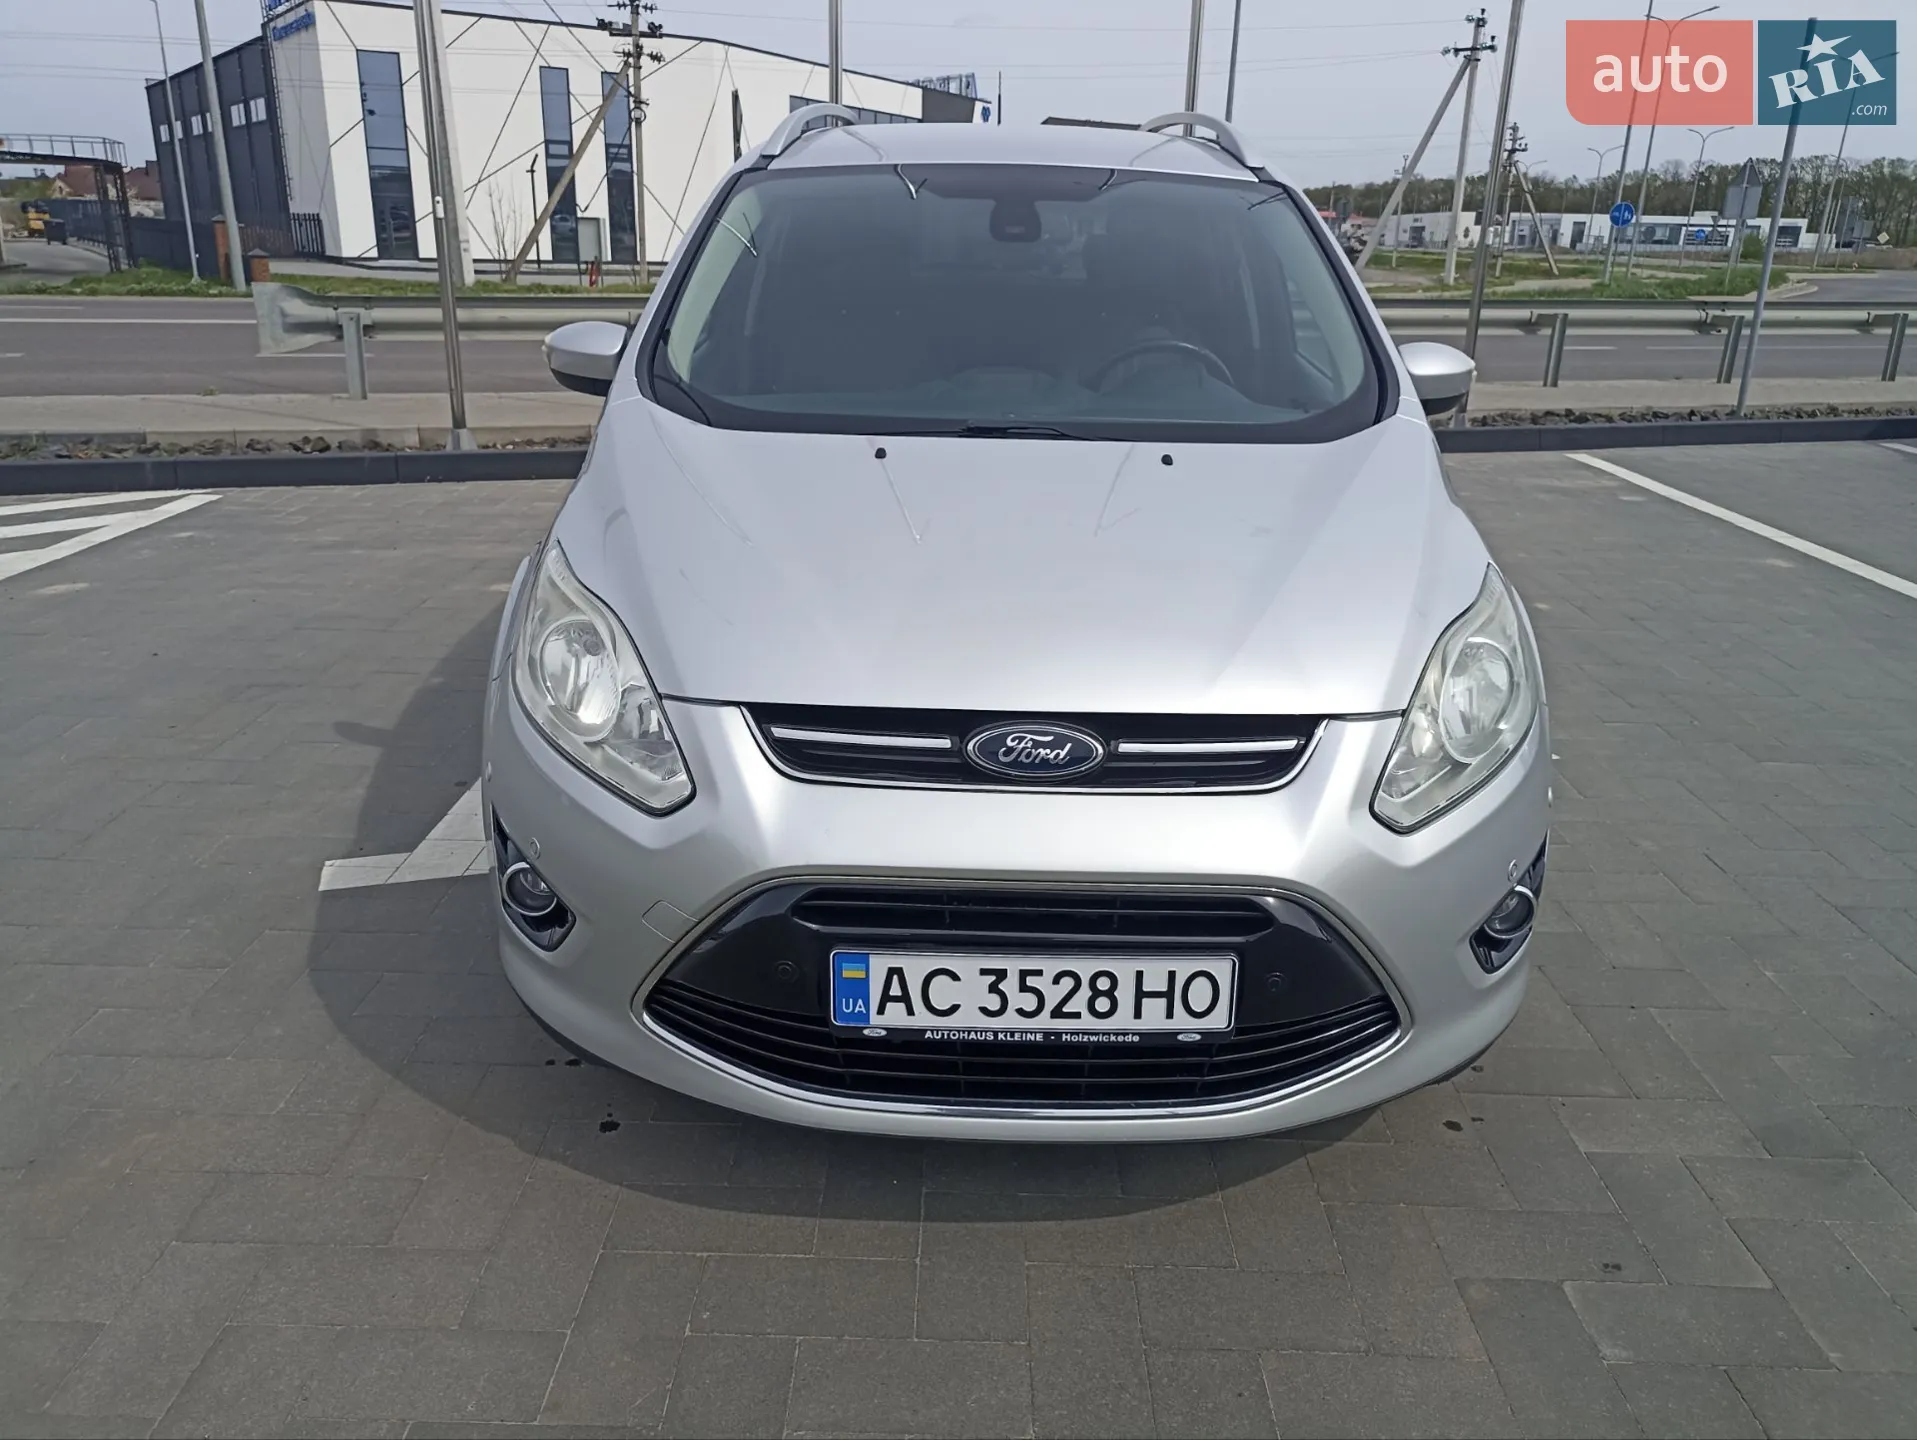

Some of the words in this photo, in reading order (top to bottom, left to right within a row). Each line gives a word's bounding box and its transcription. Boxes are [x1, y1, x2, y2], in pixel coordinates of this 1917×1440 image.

[998, 733, 1072, 765] Ford
[876, 966, 961, 1018] AC
[978, 968, 1119, 1020] 3528
[1133, 969, 1220, 1020] HO
[842, 998, 866, 1014] UA
[924, 1030, 994, 1040] AUTOHAUS
[998, 1032, 1044, 1041] KLEINE
[1062, 1033, 1140, 1042] Holzwickede
